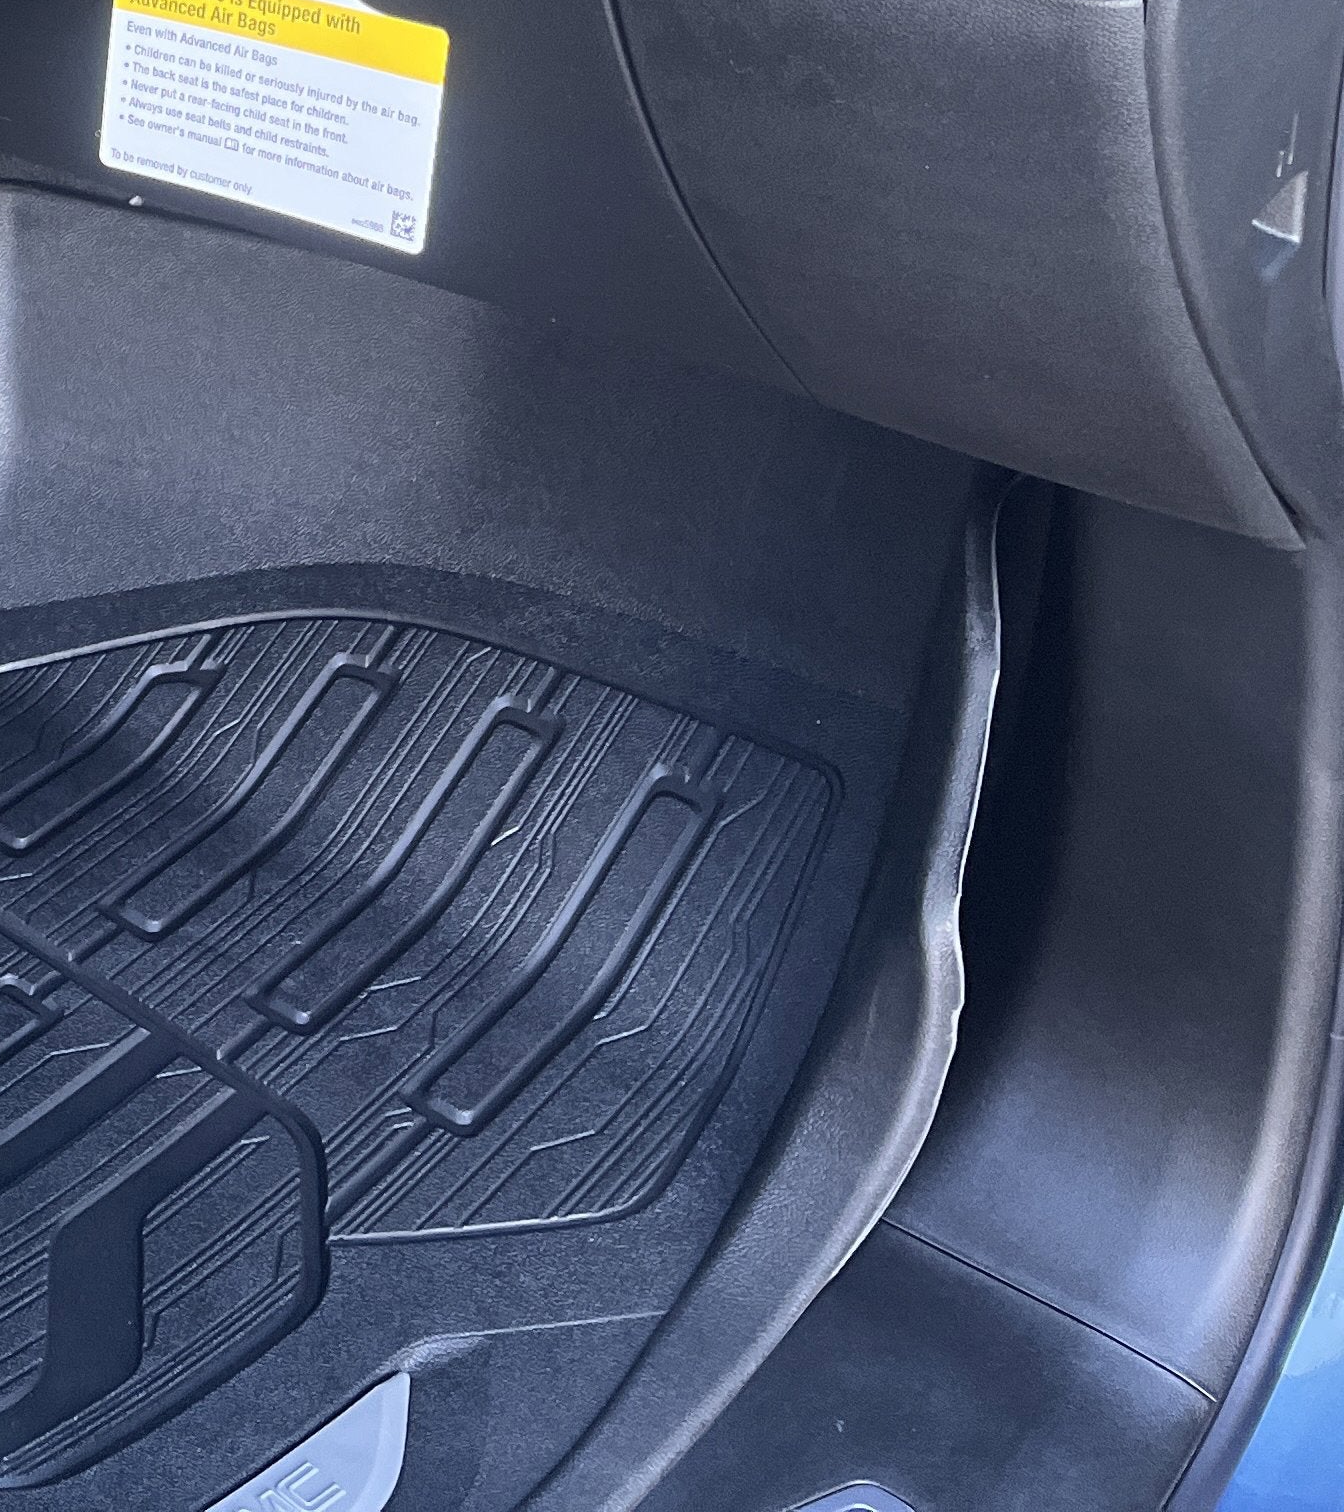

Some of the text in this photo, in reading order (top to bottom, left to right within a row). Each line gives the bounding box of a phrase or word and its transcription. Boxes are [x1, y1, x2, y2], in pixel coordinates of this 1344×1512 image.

[126, 20, 278, 67] Even with Advanced Air Bags
[210, 5, 234, 26] Air
[237, 11, 277, 38] Bags
[326, 13, 361, 35] with
[130, 79, 159, 95] Never
[161, 87, 177, 101] put
[187, 94, 241, 117] rear-facing
[243, 107, 267, 122] child
[269, 113, 290, 128] seat
[292, 119, 301, 132] in
[304, 122, 320, 136] the
[322, 127, 349, 144] front.
[132, 61, 350, 126] The back seat is the safest place for children.
[134, 44, 421, 127] Children can be killed or seriously injured by the air bag.
[127, 113, 414, 201] See owner's manual for more information about air bags.
[128, 96, 330, 158] Always use seat belts and child restraints.
[110, 147, 121, 160] To
[123, 151, 134, 163] be
[136, 155, 175, 174] removed
[177, 164, 188, 179] by
[189, 169, 232, 188] customer
